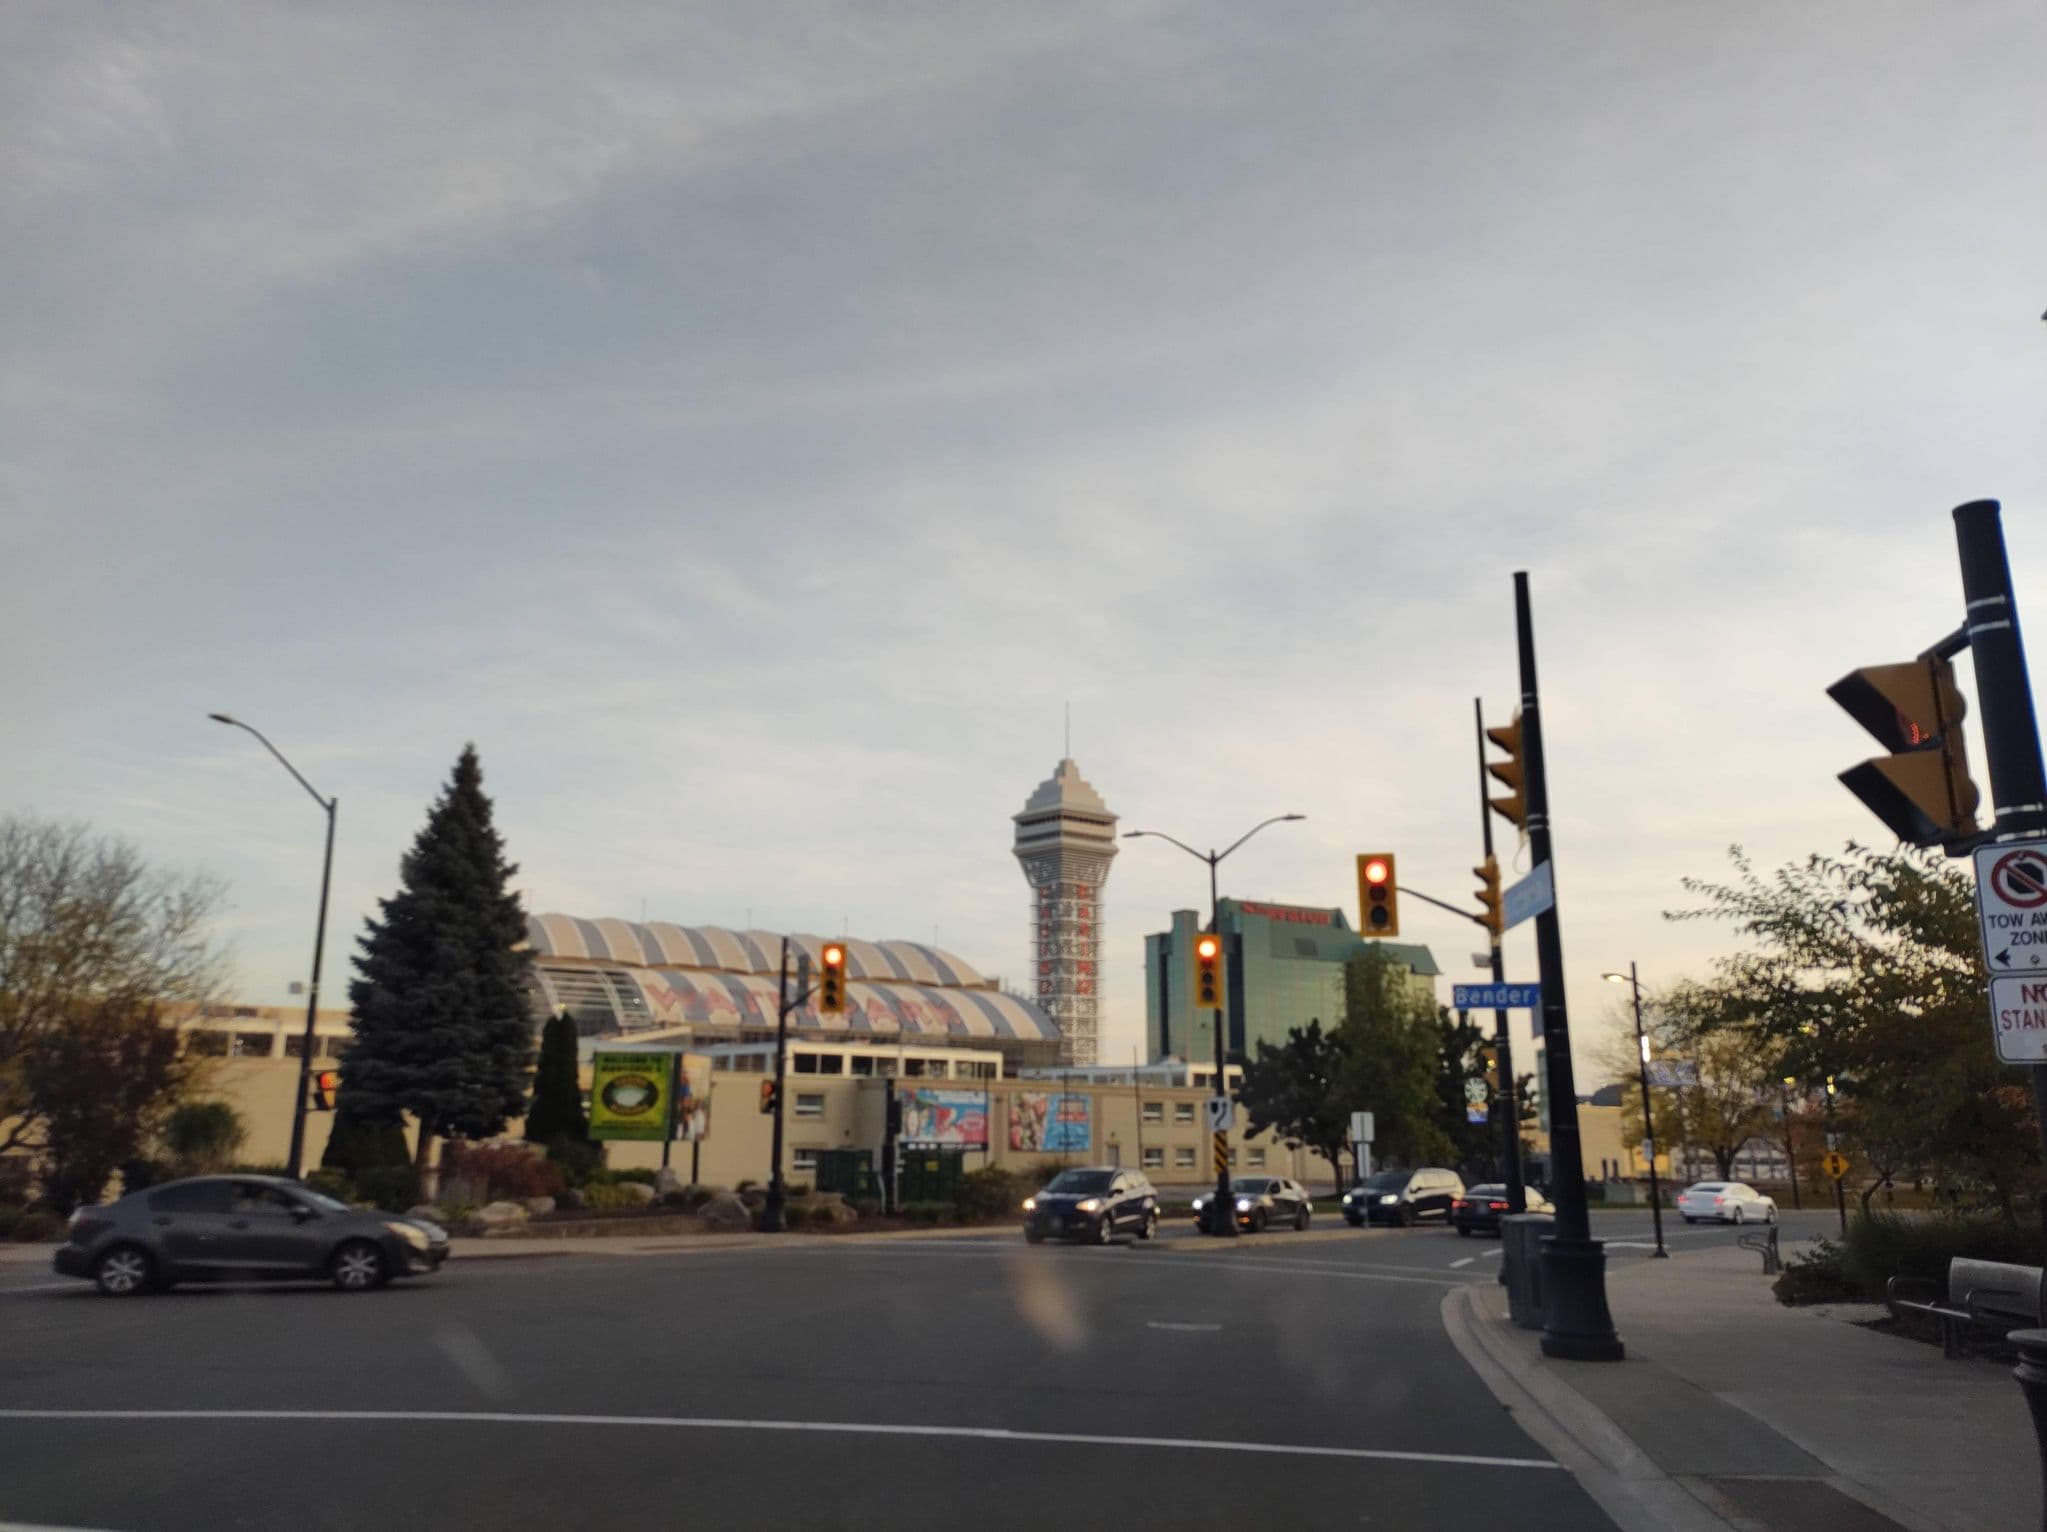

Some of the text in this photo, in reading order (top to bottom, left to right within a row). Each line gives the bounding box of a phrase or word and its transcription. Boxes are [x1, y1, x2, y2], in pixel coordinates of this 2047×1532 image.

[1988, 911, 2025, 929] TOW
[1456, 985, 1531, 1005] Bender
[2001, 1008, 2047, 1030] STAN
